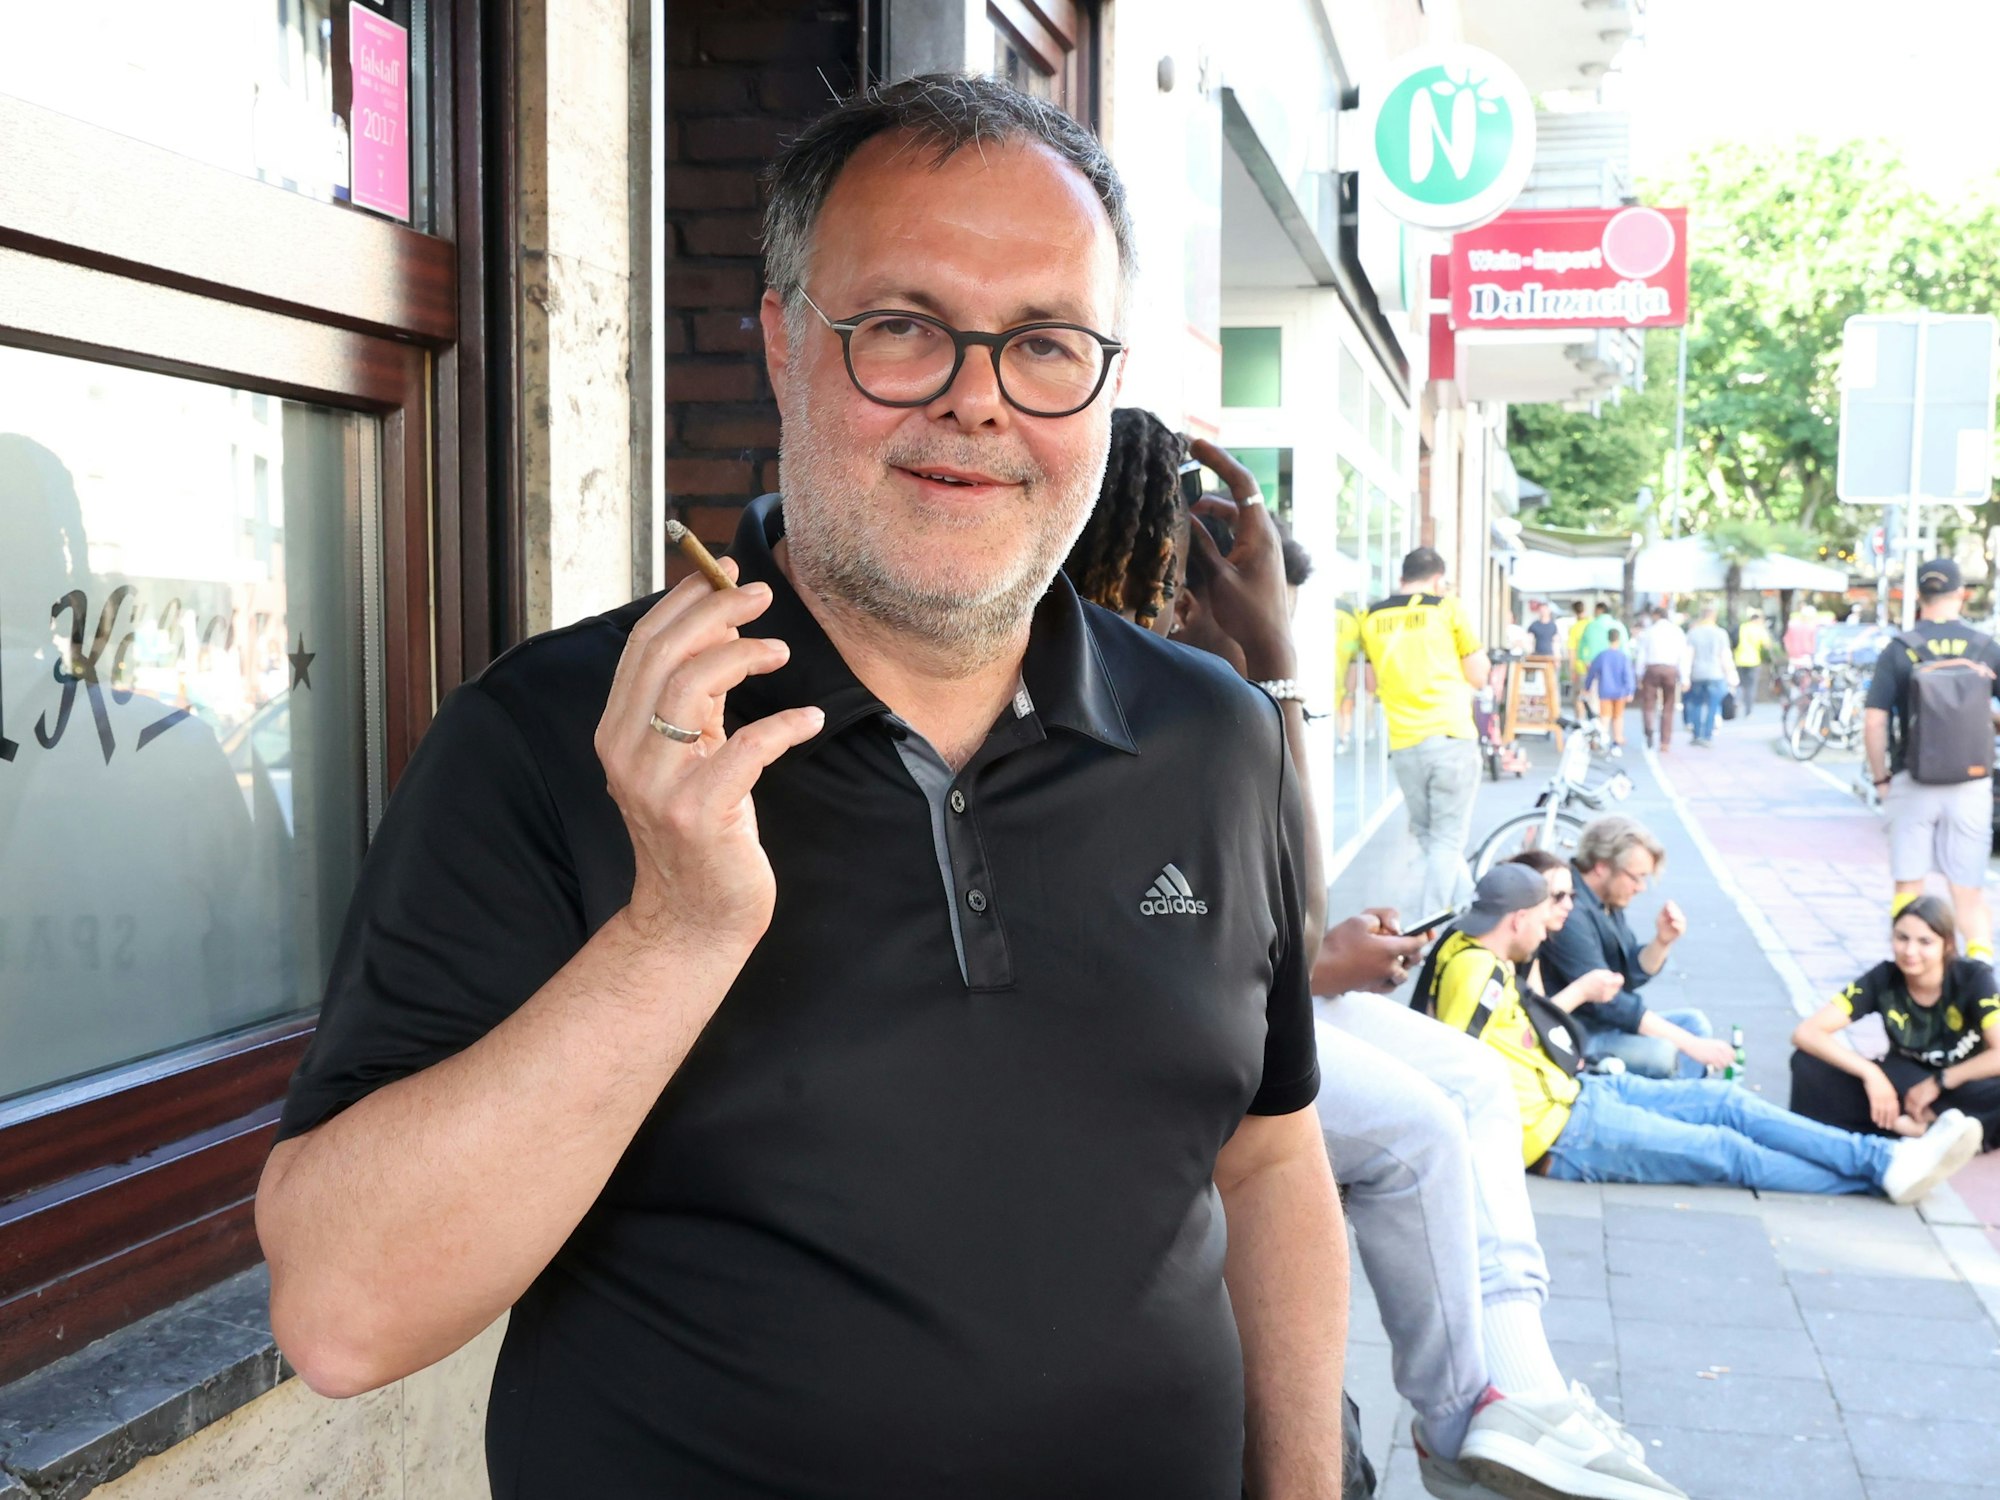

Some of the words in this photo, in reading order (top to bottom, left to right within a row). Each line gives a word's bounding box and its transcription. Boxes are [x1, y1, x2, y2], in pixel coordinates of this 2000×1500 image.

[363, 107, 397, 147] 2017
[1409, 86, 1477, 184] N
[1469, 282, 1671, 323] Dalmacija
[1139, 894, 1209, 916] adidas
